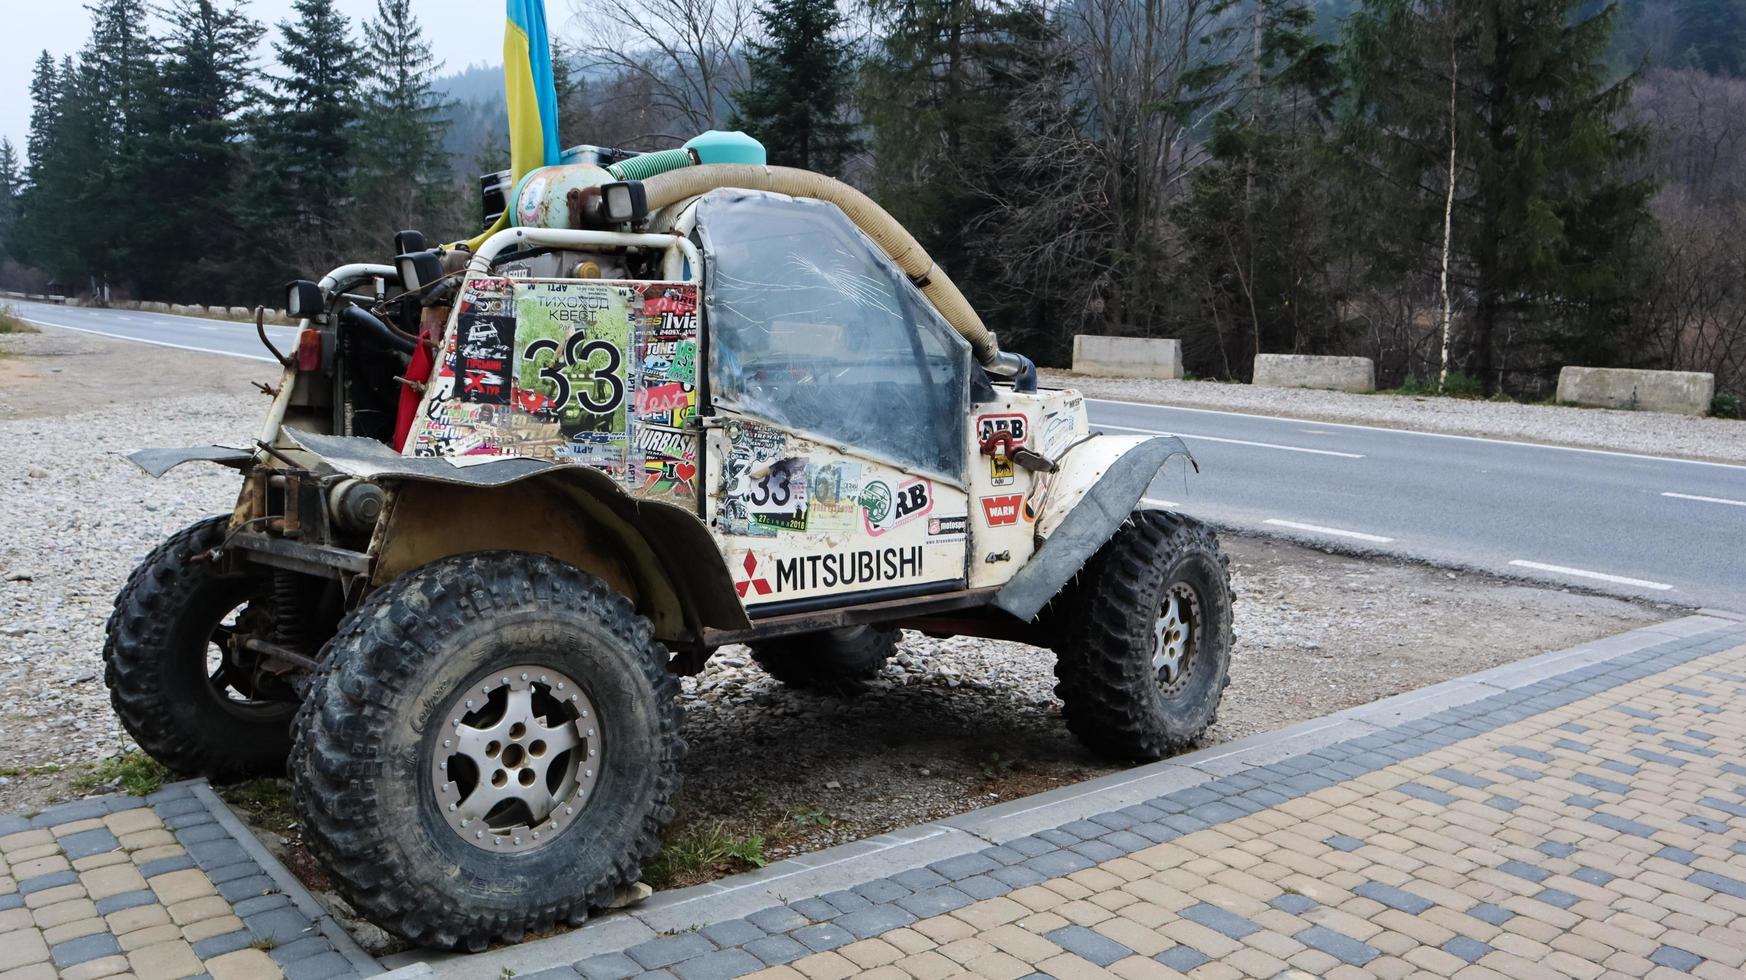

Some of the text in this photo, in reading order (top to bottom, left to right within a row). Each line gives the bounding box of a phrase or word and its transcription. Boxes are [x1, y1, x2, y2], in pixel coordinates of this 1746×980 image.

[537, 296, 610, 310] ТИХОХОД
[549, 309, 597, 321] КВЕСТ
[888, 484, 929, 521] RB
[989, 505, 1015, 518] WARN
[758, 515, 767, 523] 27
[776, 545, 923, 593] MITSUBISHI
